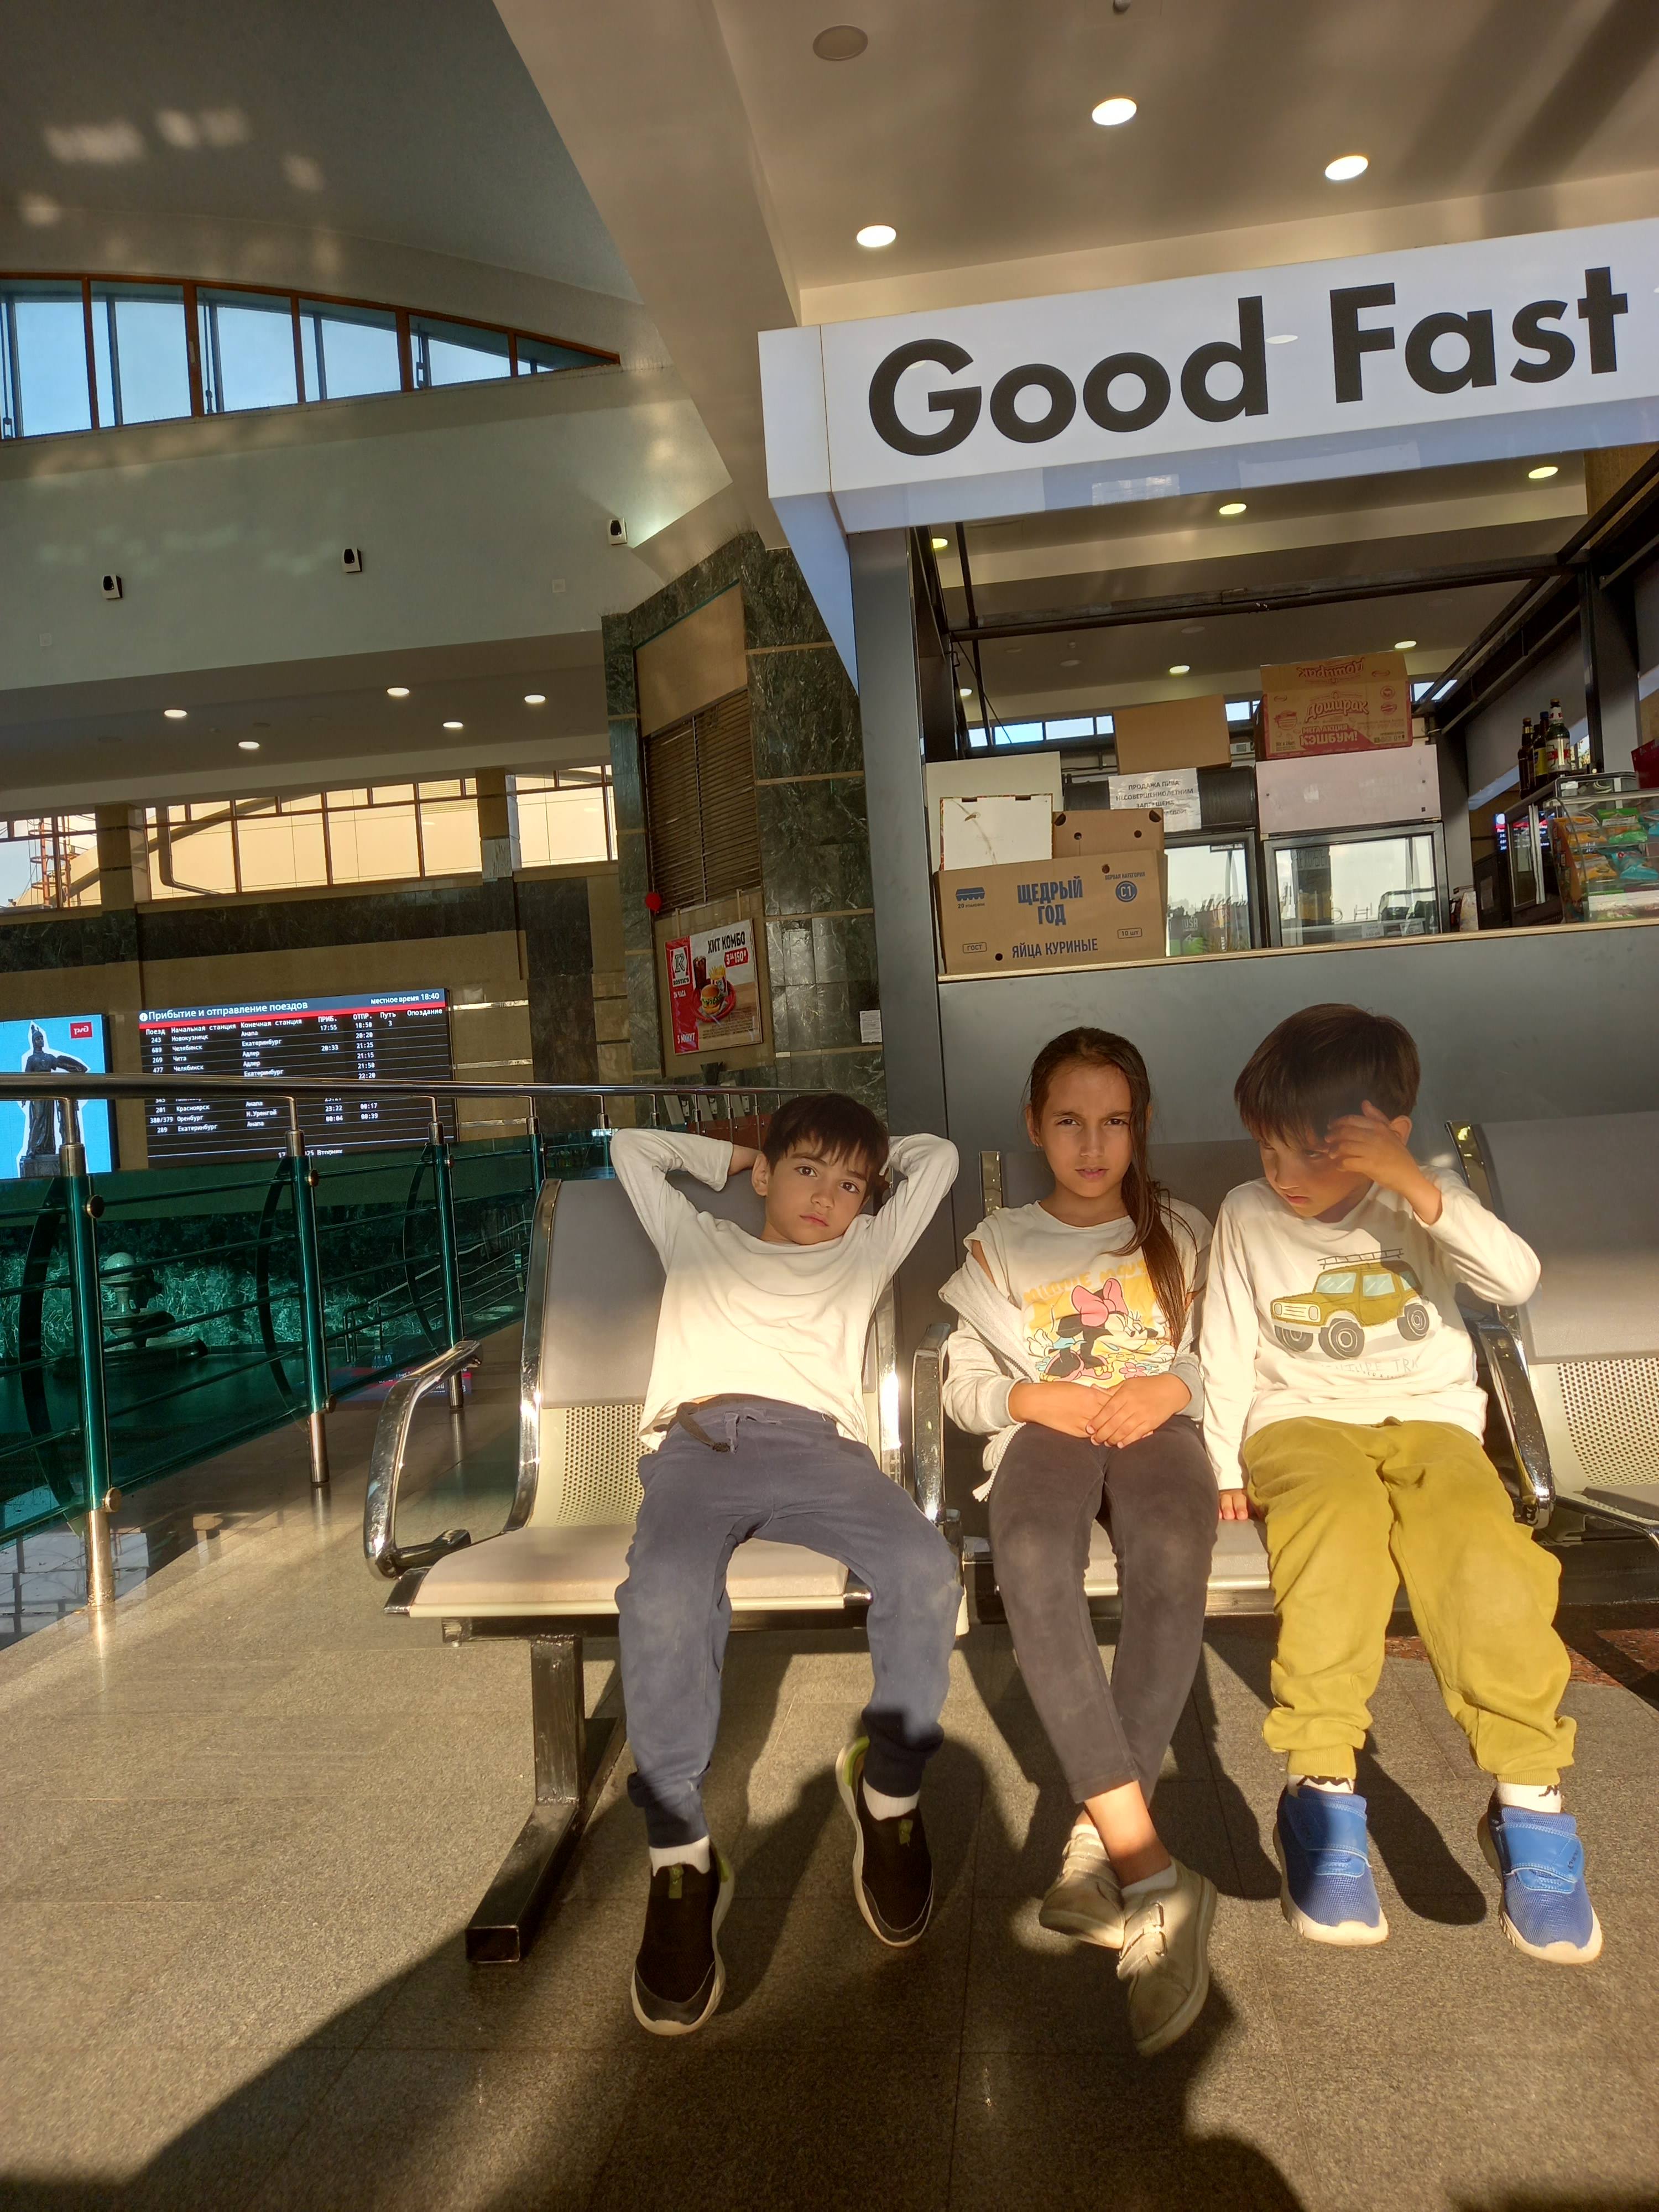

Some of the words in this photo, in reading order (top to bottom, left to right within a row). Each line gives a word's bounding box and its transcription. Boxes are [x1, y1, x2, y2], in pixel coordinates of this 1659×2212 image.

[869, 295, 1268, 456] Good
[1329, 266, 1629, 404] Fast
[1305, 700, 1369, 723] Доширак
[1300, 731, 1358, 745] КЭШБУМ!
[1302, 726, 1321, 734] МЕГА
[1321, 723, 1348, 733] АКЦИЯ
[1116, 788, 1193, 801] НЕСОВЕРШЕННОЛЕТНИМ
[1017, 875, 1083, 905] ЩЕДРЫЙ
[1037, 904, 1066, 926] ГОД
[708, 938, 720, 954] ХИТ
[722, 931, 745, 950] КОМБО
[1012, 942, 1042, 958] ЯЙЦА
[1046, 938, 1098, 954] КУРИНЫЕ
[149, 1010, 196, 1022] Прибытие
[207, 1005, 268, 1016] отправление
[269, 1002, 308, 1012] поездов
[244, 1069, 284, 1077] Екатеринбург
[246, 1109, 277, 1118] Н.Уренгой
[178, 1124, 217, 1133] Екатеринбург
